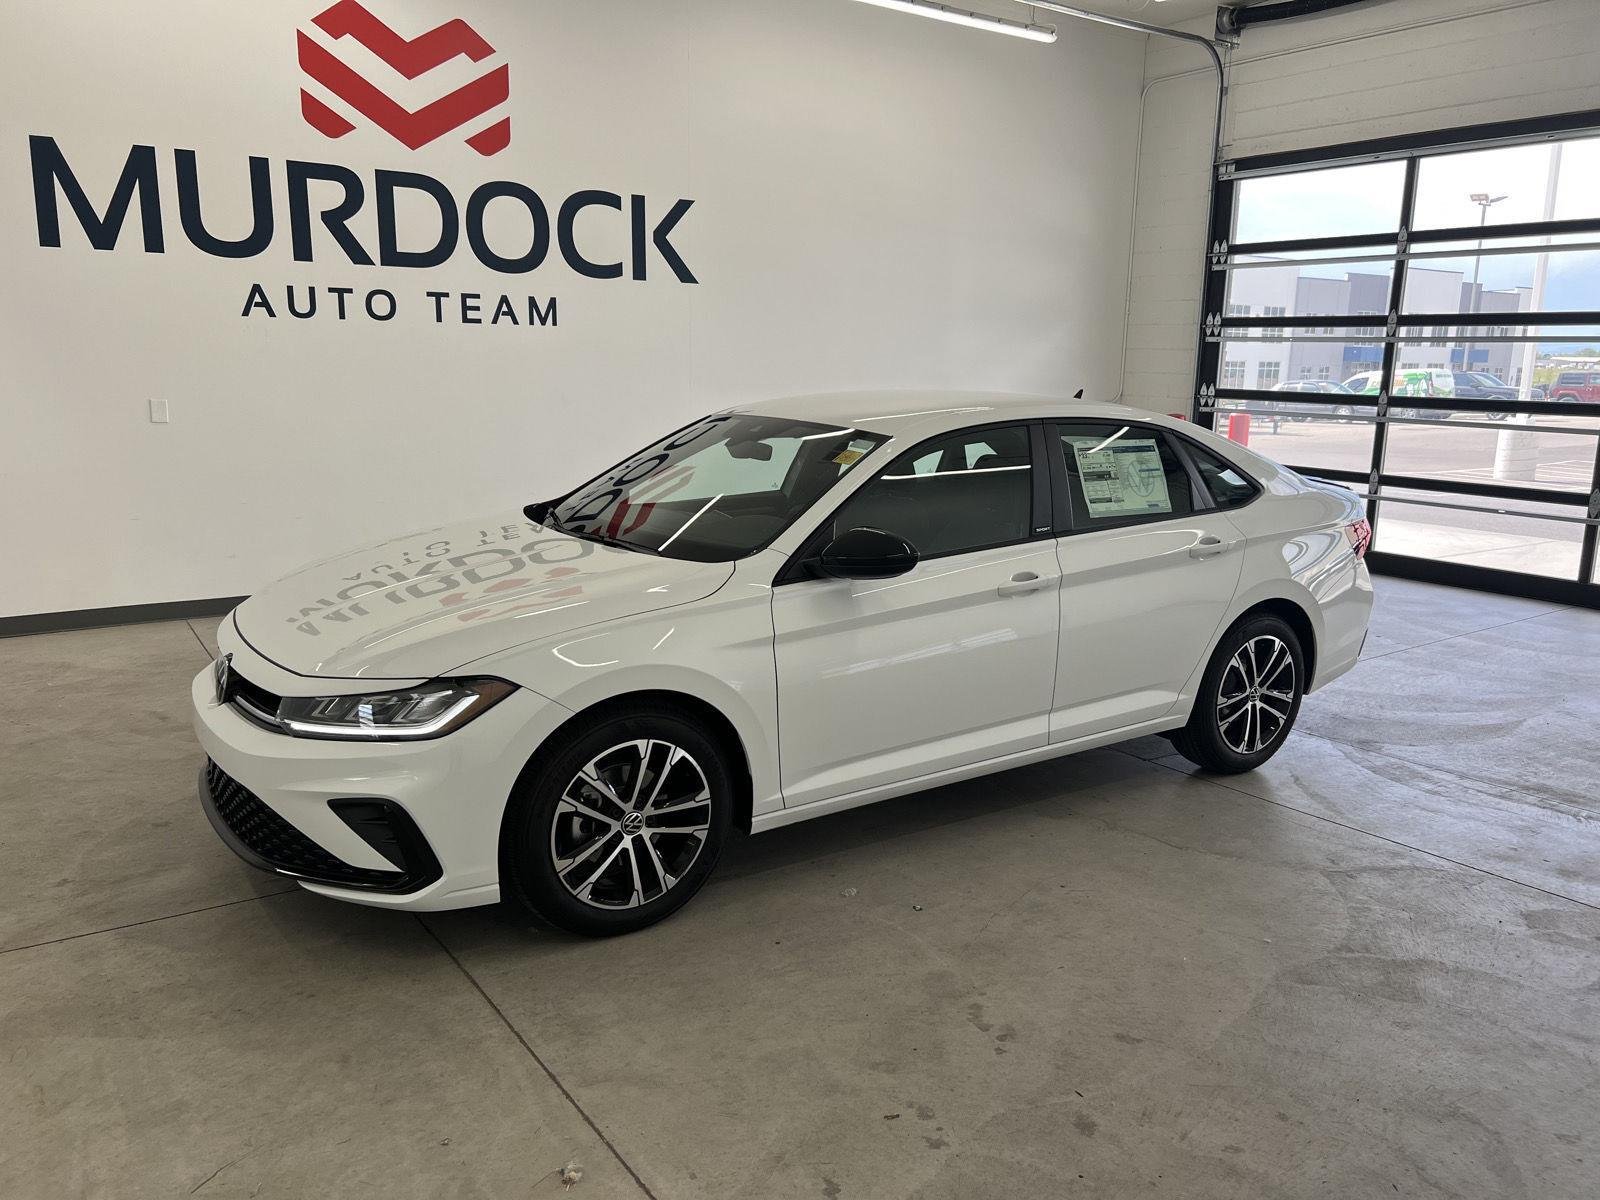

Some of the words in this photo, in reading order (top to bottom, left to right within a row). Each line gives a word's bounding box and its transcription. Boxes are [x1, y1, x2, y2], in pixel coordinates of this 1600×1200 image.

[29, 134, 699, 285] MURDOCK
[242, 284, 397, 321] AUTO
[427, 291, 559, 327] TEAM
